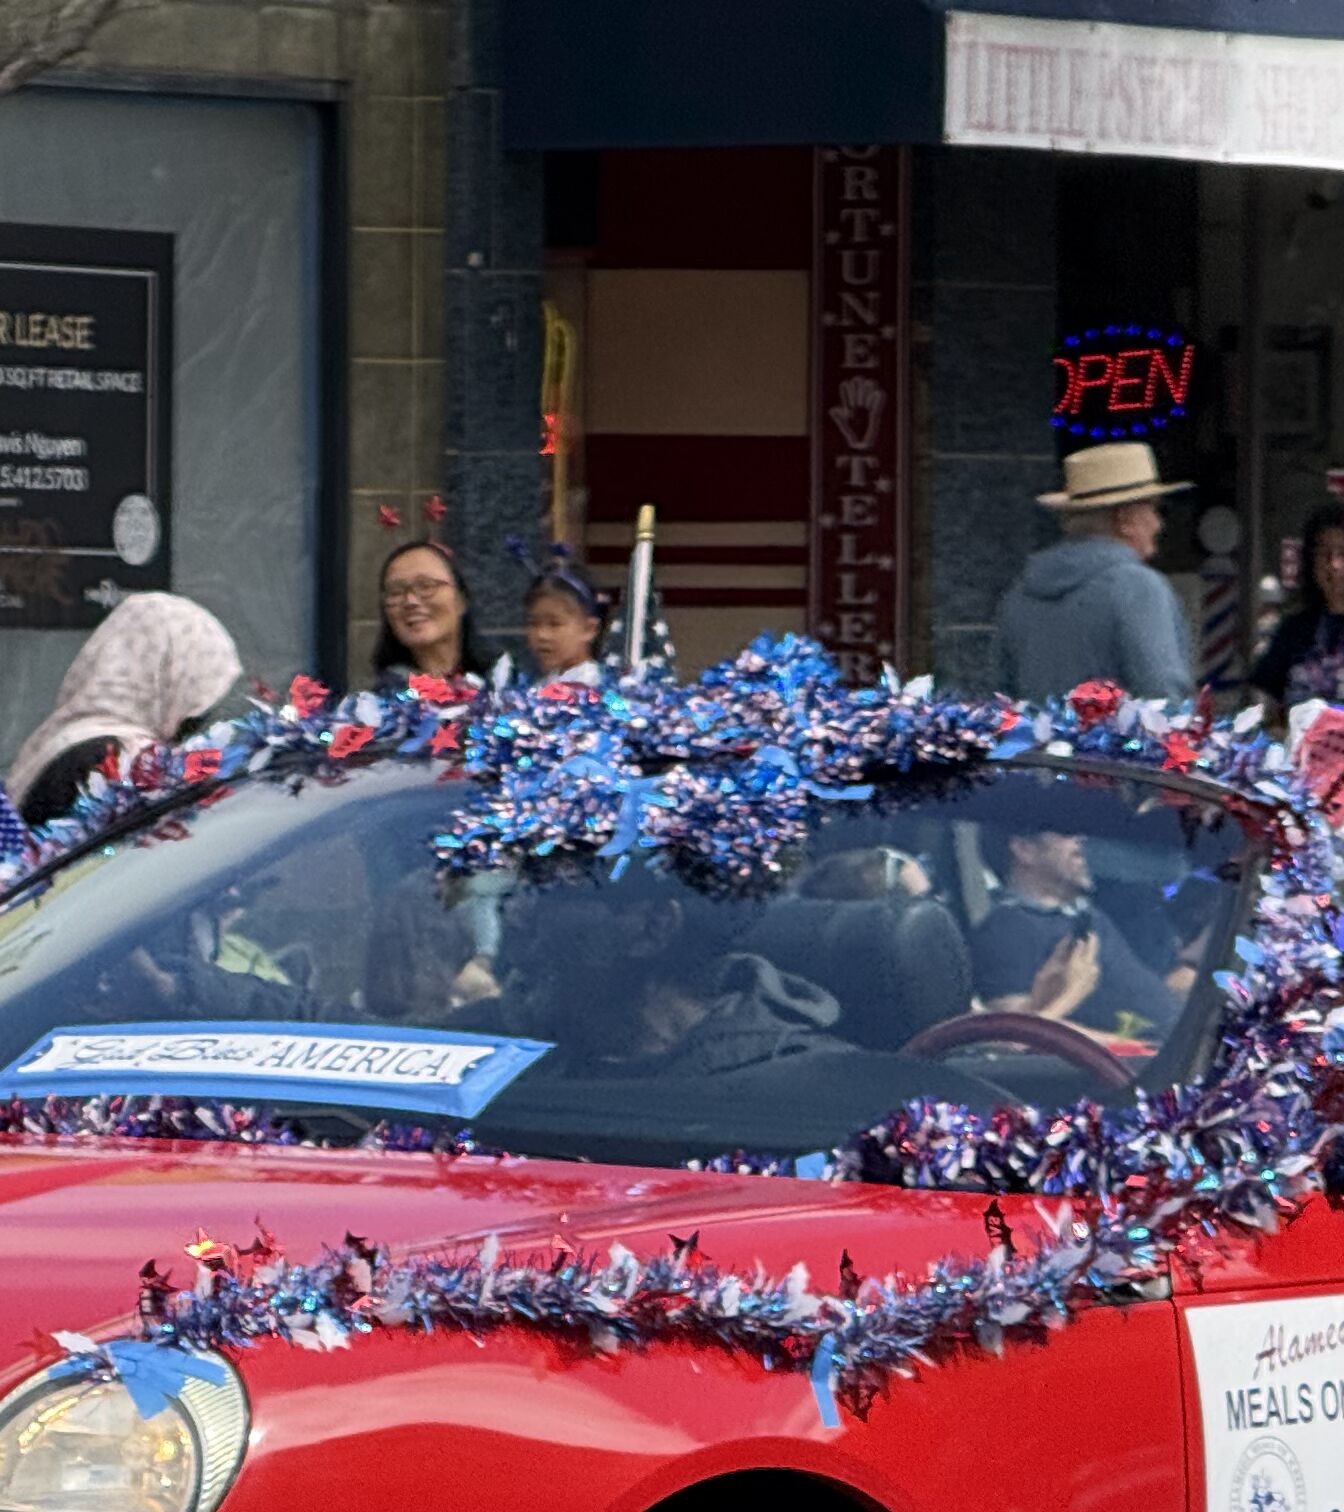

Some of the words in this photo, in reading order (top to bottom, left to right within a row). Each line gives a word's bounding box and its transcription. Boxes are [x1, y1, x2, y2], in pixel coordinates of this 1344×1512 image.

[14, 313, 97, 350] LEASE
[255, 1040, 455, 1078] AMERICA
[1225, 1382, 1313, 1432] MEALS
